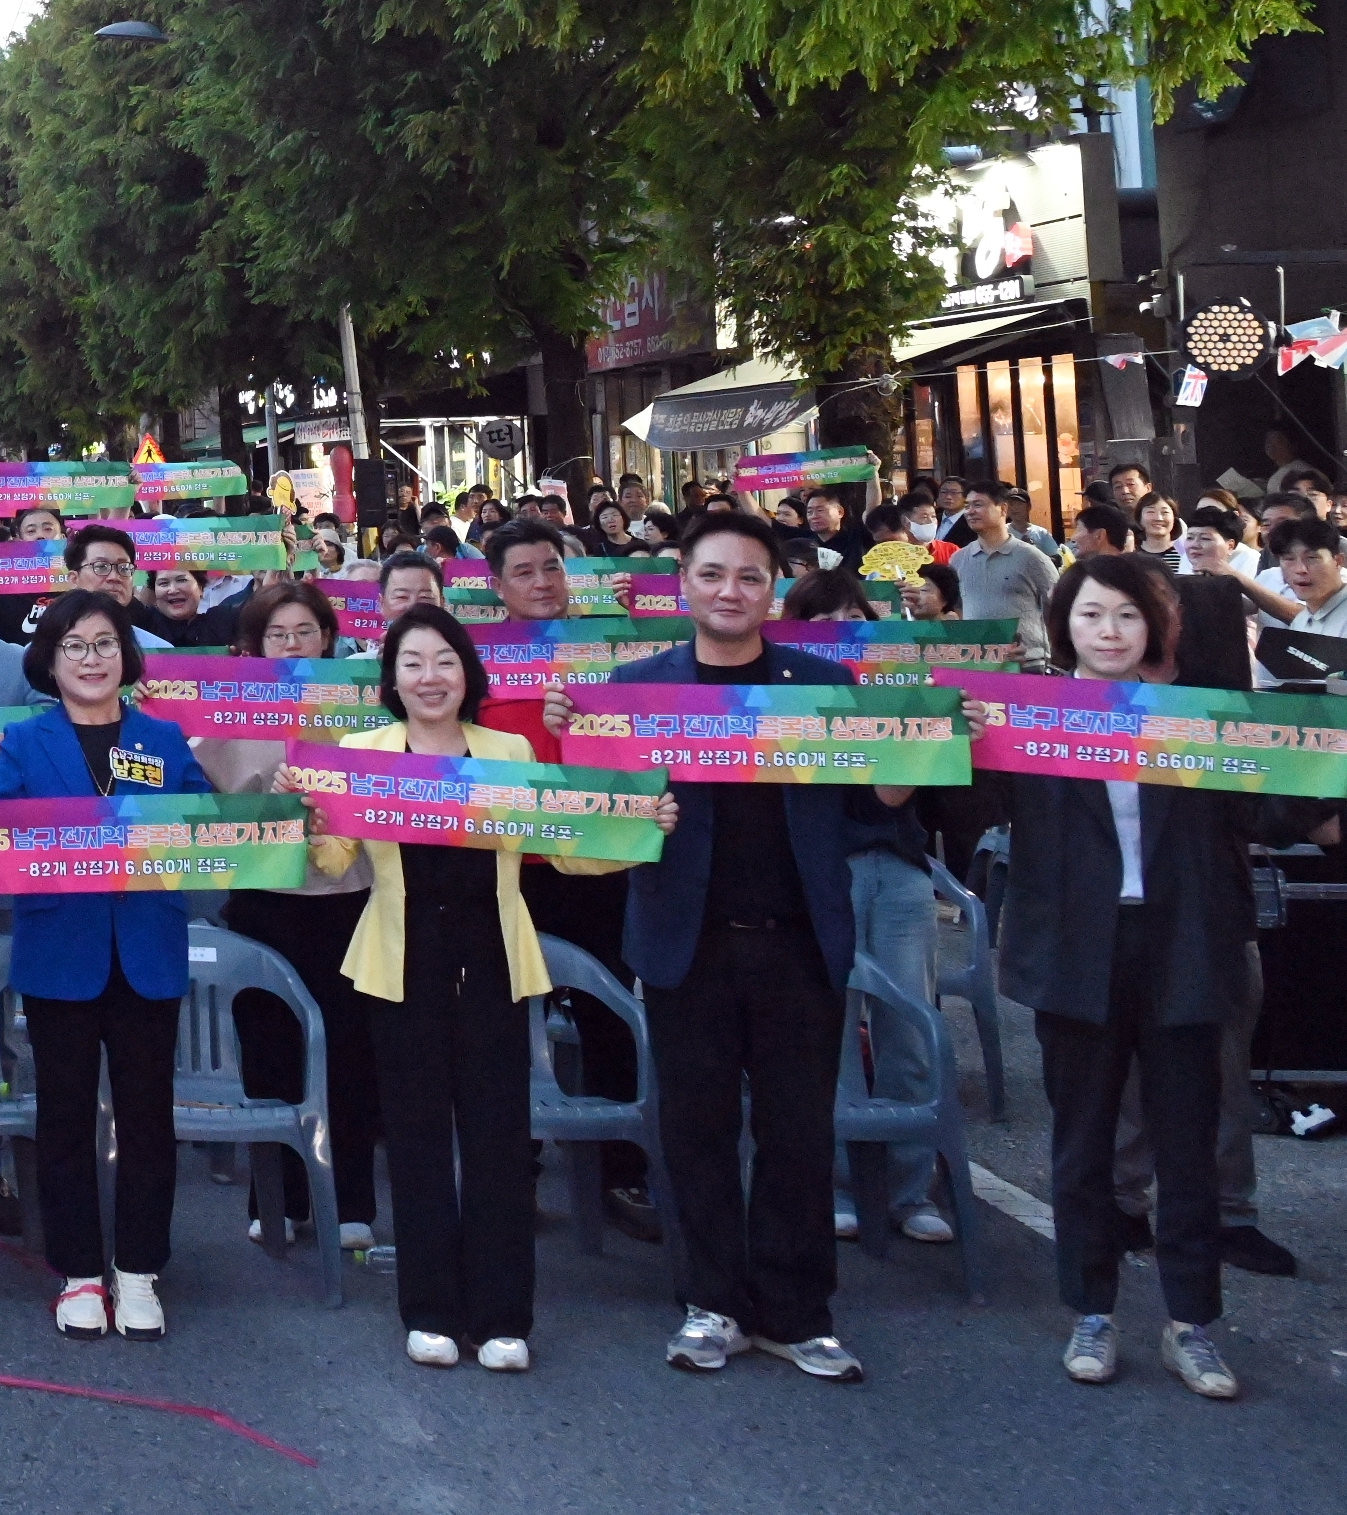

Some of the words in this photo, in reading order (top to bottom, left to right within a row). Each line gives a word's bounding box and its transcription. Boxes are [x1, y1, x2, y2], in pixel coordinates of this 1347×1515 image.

[486, 424, 515, 458] 떡
[13, 492, 36, 500] 상점가
[38, 492, 73, 500] 6,660개
[74, 492, 95, 500] 점포-
[144, 551, 172, 561] 상점가
[174, 551, 215, 561] 6,660개
[218, 551, 242, 560] 점포-
[21, 575, 46, 584] 상점가
[635, 595, 676, 611] 2025
[492, 644, 552, 664] 전지역
[553, 643, 611, 665] 골목형
[863, 643, 920, 664] 골목형
[923, 644, 982, 664] 상점가
[1287, 645, 1330, 671] SHURE
[859, 672, 919, 686] 6,660개
[147, 680, 197, 700] 2025
[200, 681, 239, 701] 남구
[241, 682, 301, 703] 전지역
[301, 684, 359, 706] 골목형
[204, 712, 247, 725] -82개
[253, 713, 294, 726] 상점가
[298, 714, 358, 728] 6,660개
[568, 715, 630, 737] 2025
[632, 715, 679, 737] 남구
[683, 715, 753, 739] 전지역
[755, 715, 827, 741] 골목형
[829, 717, 903, 742] 상점가
[903, 717, 953, 742] 지정
[1009, 703, 1059, 730] 남구
[1063, 708, 1140, 738] 전지역
[1140, 714, 1217, 745] 골목형
[1220, 721, 1300, 750] 상점가
[639, 750, 692, 766] -82개
[698, 750, 749, 766] 상점가
[754, 751, 827, 768] 6,660개
[832, 752, 879, 768] 점포-
[1013, 742, 1069, 760] -82개
[1075, 746, 1130, 765] 상점가
[1136, 750, 1215, 771] 6,660개
[1221, 758, 1271, 775] 점포-
[112, 758, 163, 786] 남호현
[291, 766, 348, 794] 2025
[351, 772, 395, 799] 남구
[398, 778, 468, 805] 전지역
[468, 783, 538, 811] 골목형
[539, 789, 611, 816] 상점가
[613, 793, 659, 819] 지정
[12, 827, 56, 850] 남구
[59, 825, 124, 849] 전지역
[127, 824, 192, 849] 골목형
[194, 822, 260, 847] 상점가
[261, 819, 304, 844] 지정
[353, 810, 404, 827] -82개
[411, 813, 459, 831] 상점가
[464, 817, 535, 837] 6,660개
[540, 823, 584, 841] 점포-
[18, 860, 67, 878] -82개
[72, 860, 120, 876] 상점가
[124, 858, 191, 876] 6,660개
[197, 858, 239, 873] 점포-
